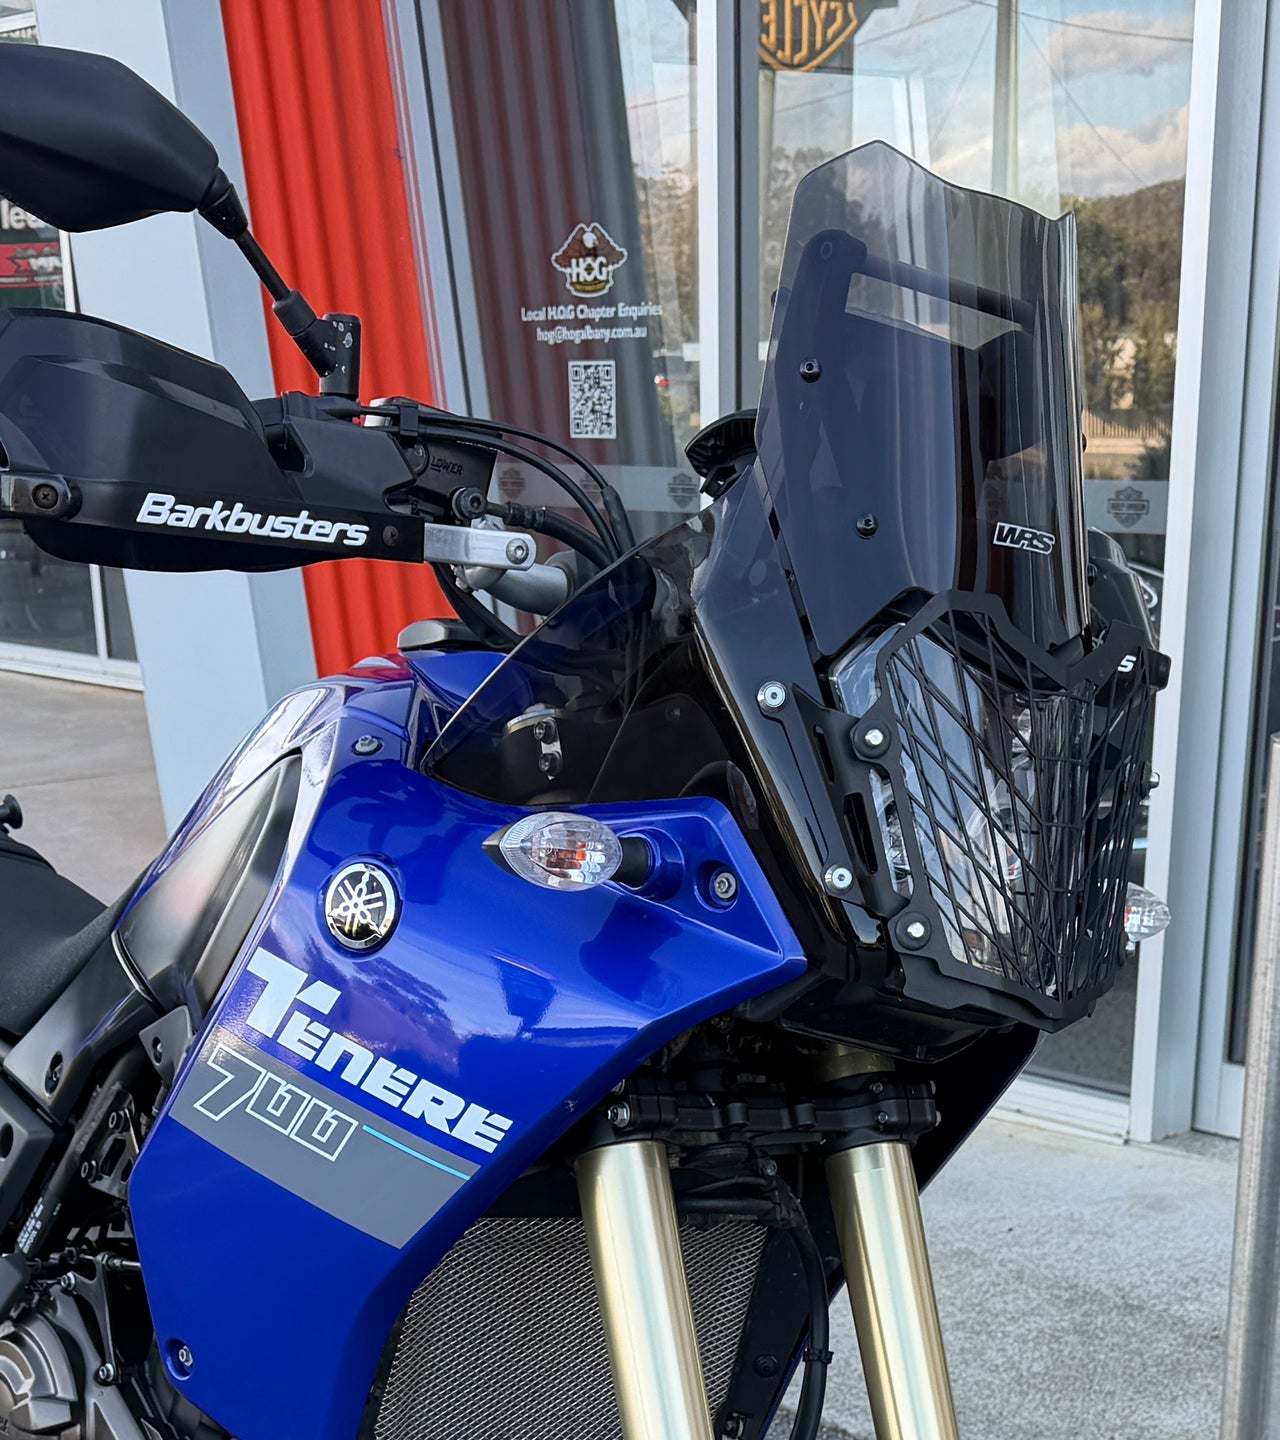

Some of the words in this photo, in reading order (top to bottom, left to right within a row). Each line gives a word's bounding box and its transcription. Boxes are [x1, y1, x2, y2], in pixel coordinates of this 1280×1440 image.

[570, 255, 608, 283] HOG
[521, 307, 546, 321] Local
[576, 304, 617, 322] Chapter
[617, 301, 663, 321] Enquiries
[136, 492, 370, 547] Barkbusters
[993, 522, 1056, 554] WRS
[193, 1044, 359, 1162] 700
